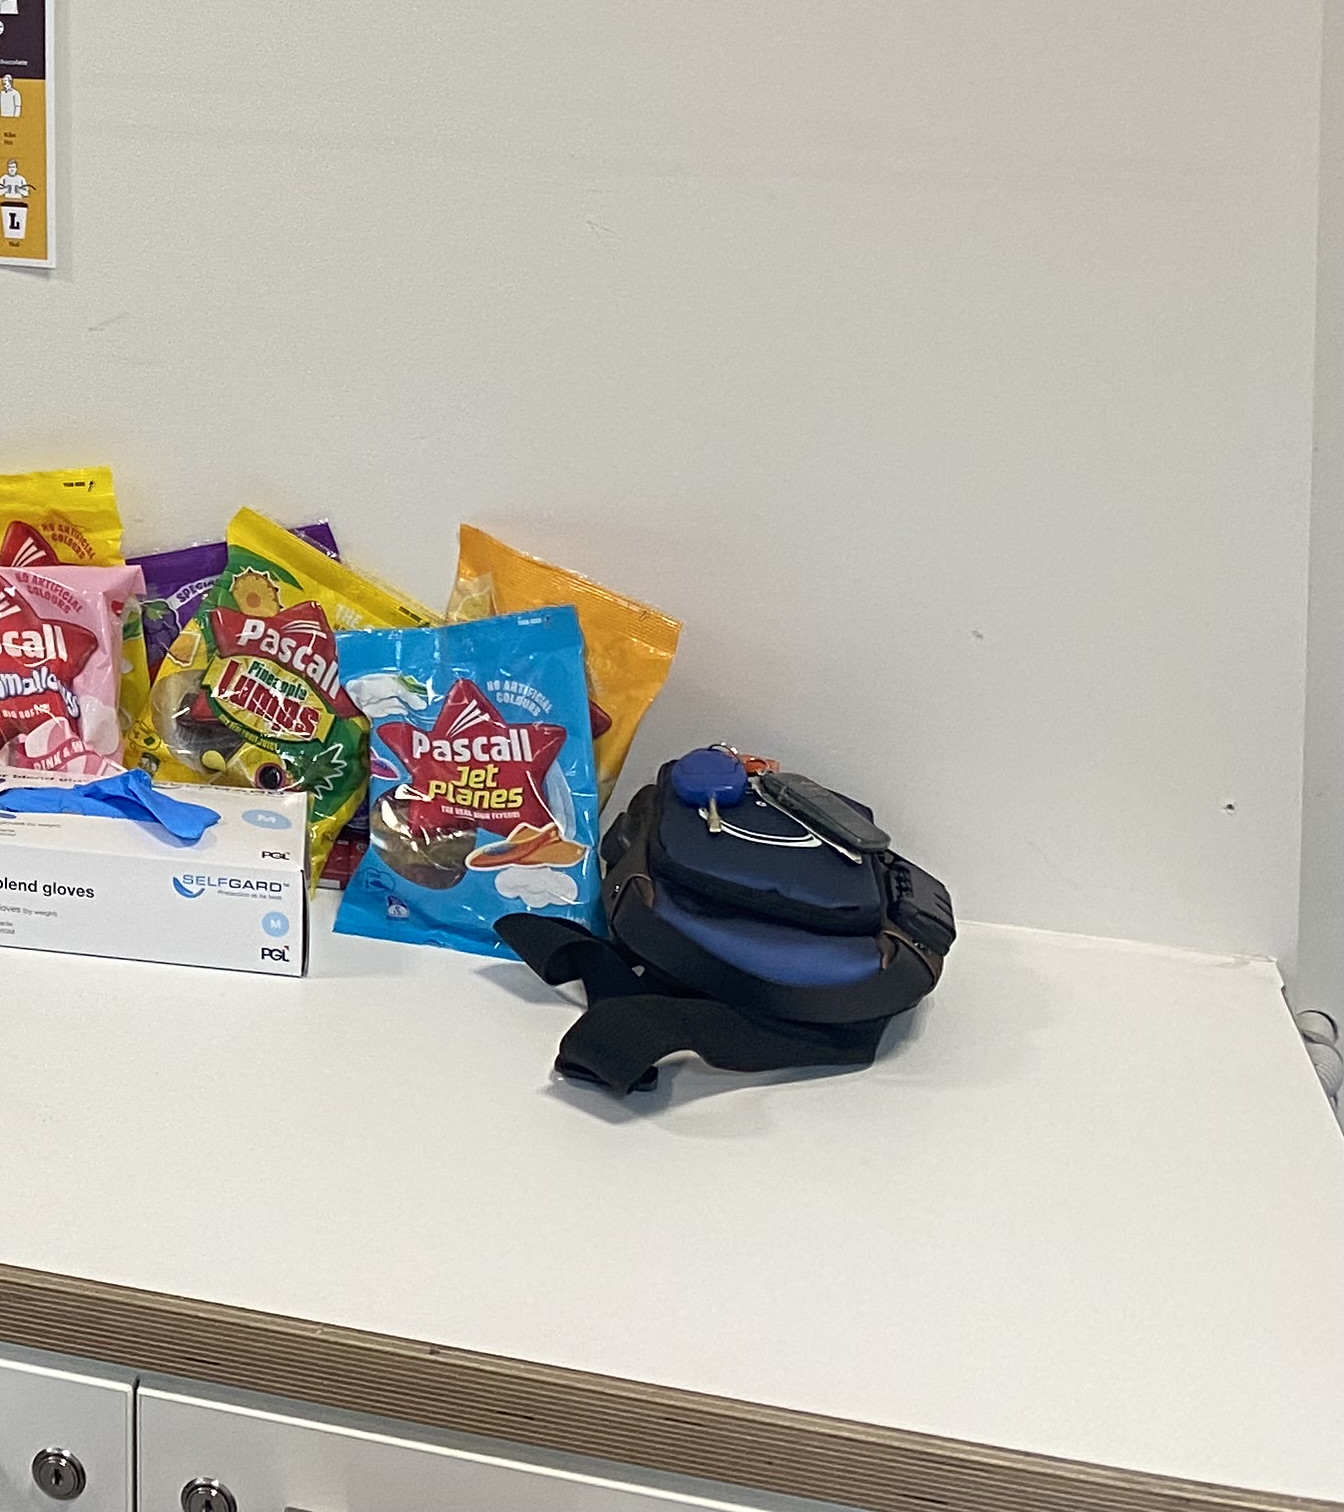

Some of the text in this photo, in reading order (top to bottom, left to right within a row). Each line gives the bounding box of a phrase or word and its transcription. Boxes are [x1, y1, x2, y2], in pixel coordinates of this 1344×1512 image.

[9, 212, 20, 230] L
[57, 521, 96, 561] ARTIFICIAL
[15, 571, 84, 615] NO ARTIFICIAL
[26, 586, 73, 615] COLOURS
[236, 618, 341, 700] Pascall
[247, 660, 308, 701] Pineapple
[213, 658, 321, 742] Lumps
[486, 679, 554, 715] NO ARTIFICIAL
[496, 691, 542, 717] COLOURS
[412, 728, 533, 762] Pascall
[451, 763, 499, 788] Jet
[427, 779, 524, 810] Planes
[256, 814, 277, 824] M
[261, 851, 290, 861] PGL
[42, 881, 96, 899] gloves
[270, 918, 282, 930] M
[261, 946, 290, 962] PGL
